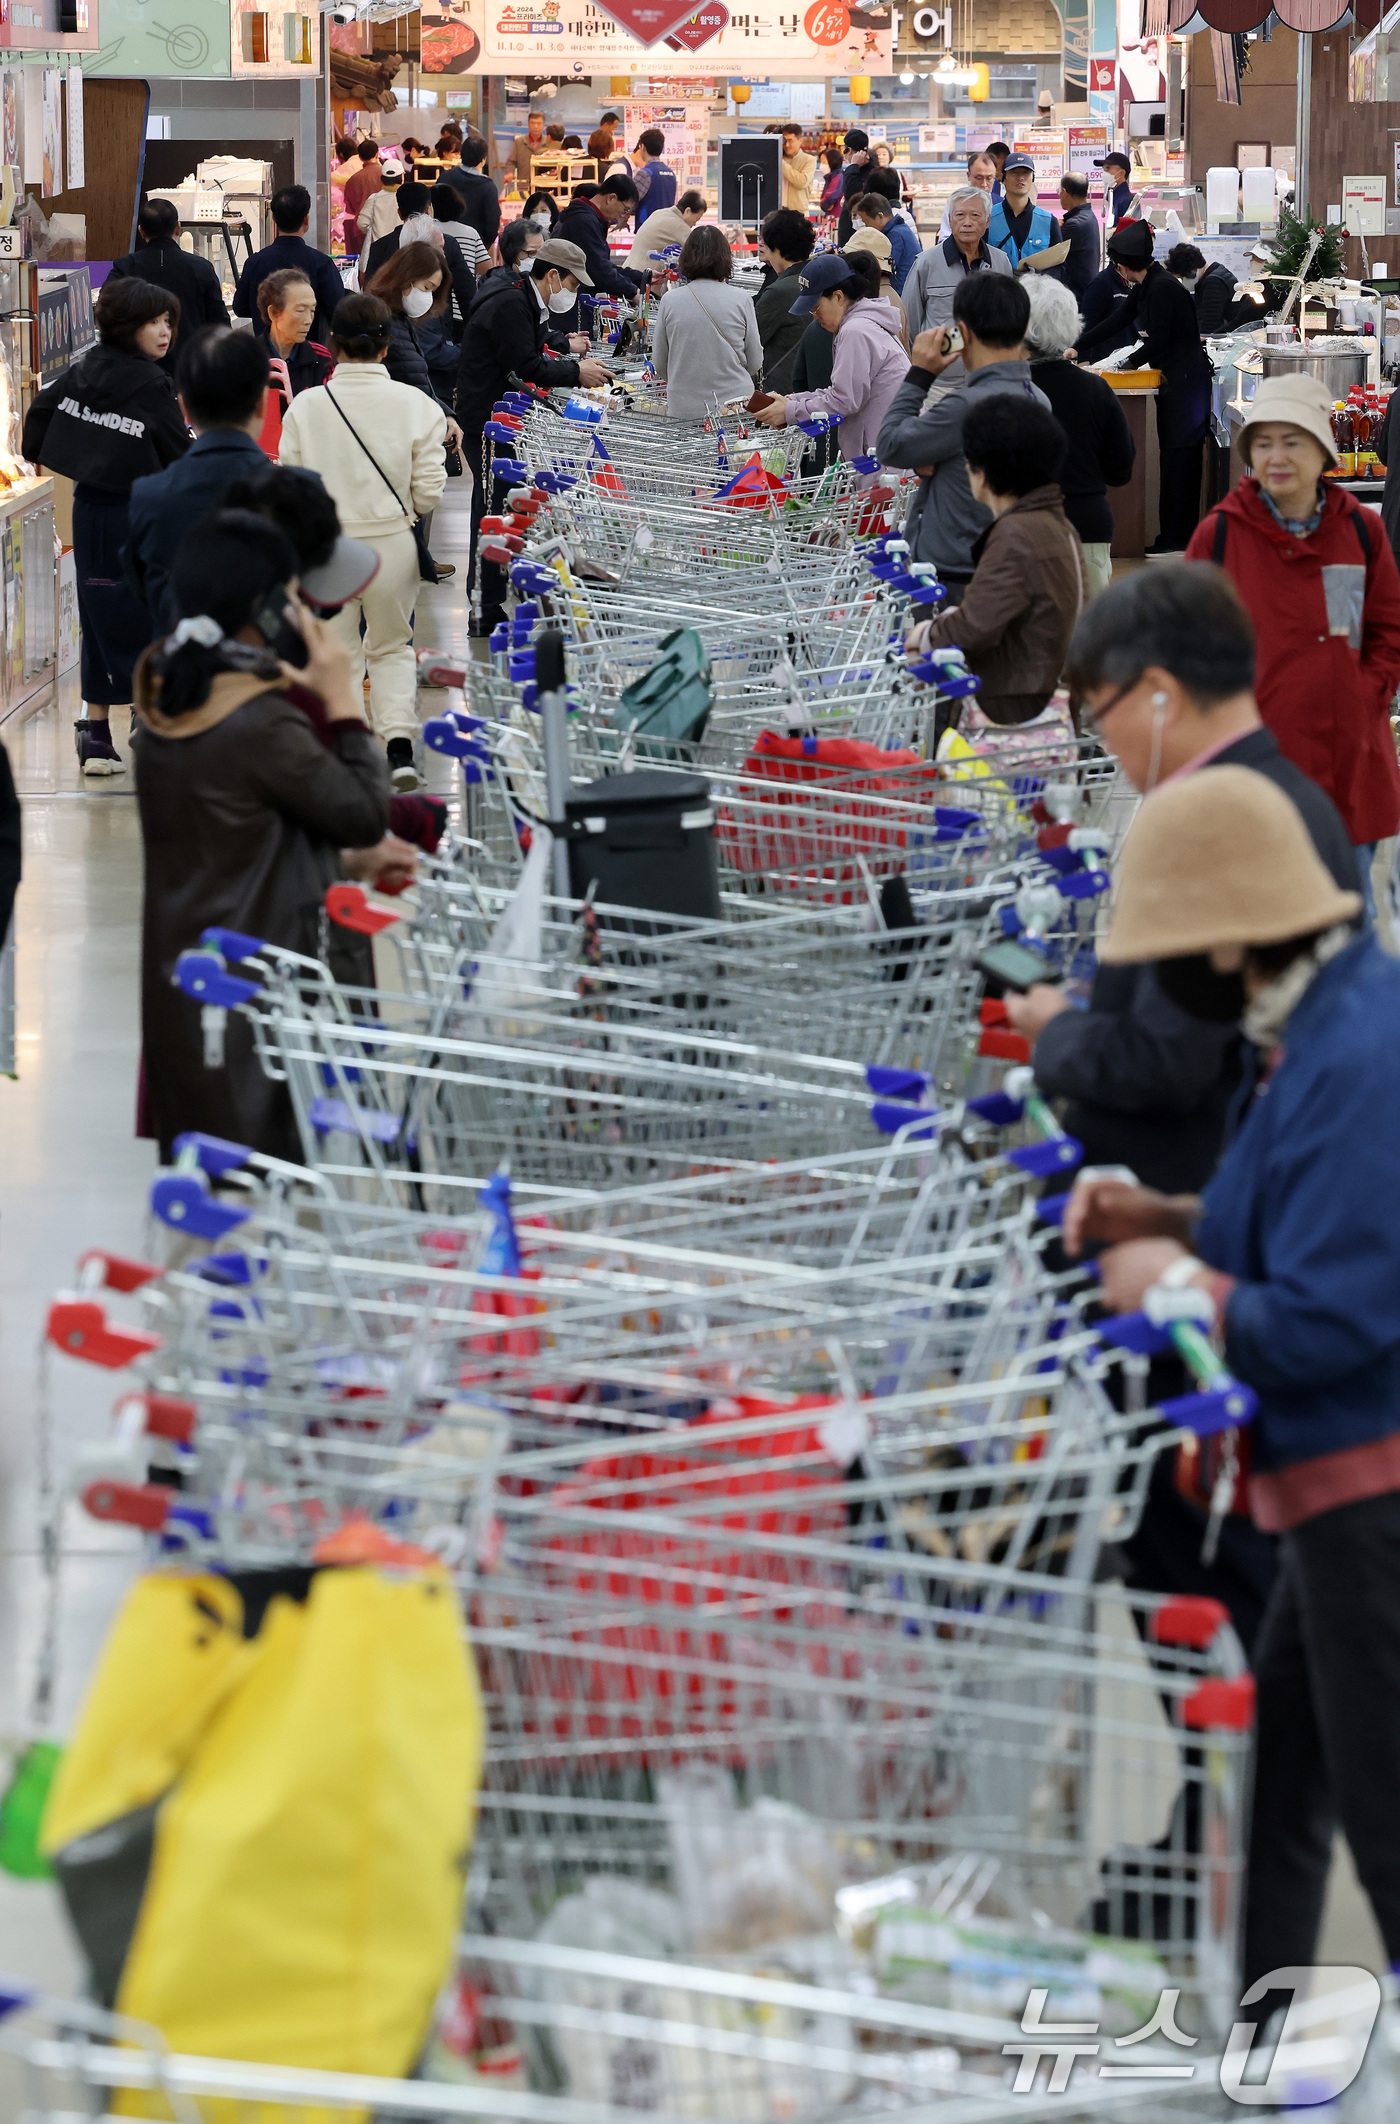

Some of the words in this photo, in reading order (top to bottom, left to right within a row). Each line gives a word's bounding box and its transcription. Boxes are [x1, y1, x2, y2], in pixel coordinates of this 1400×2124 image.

[501, 23, 528, 32] 대한민국
[532, 23, 559, 32] 한우세일
[700, 15, 722, 26] 촬영중
[731, 14, 773, 37] 먹는
[779, 14, 800, 37] 날
[825, 29, 843, 40] 세일
[1096, 66, 1112, 86] 6
[57, 396, 81, 418] JIL
[81, 406, 145, 438] SANDER
